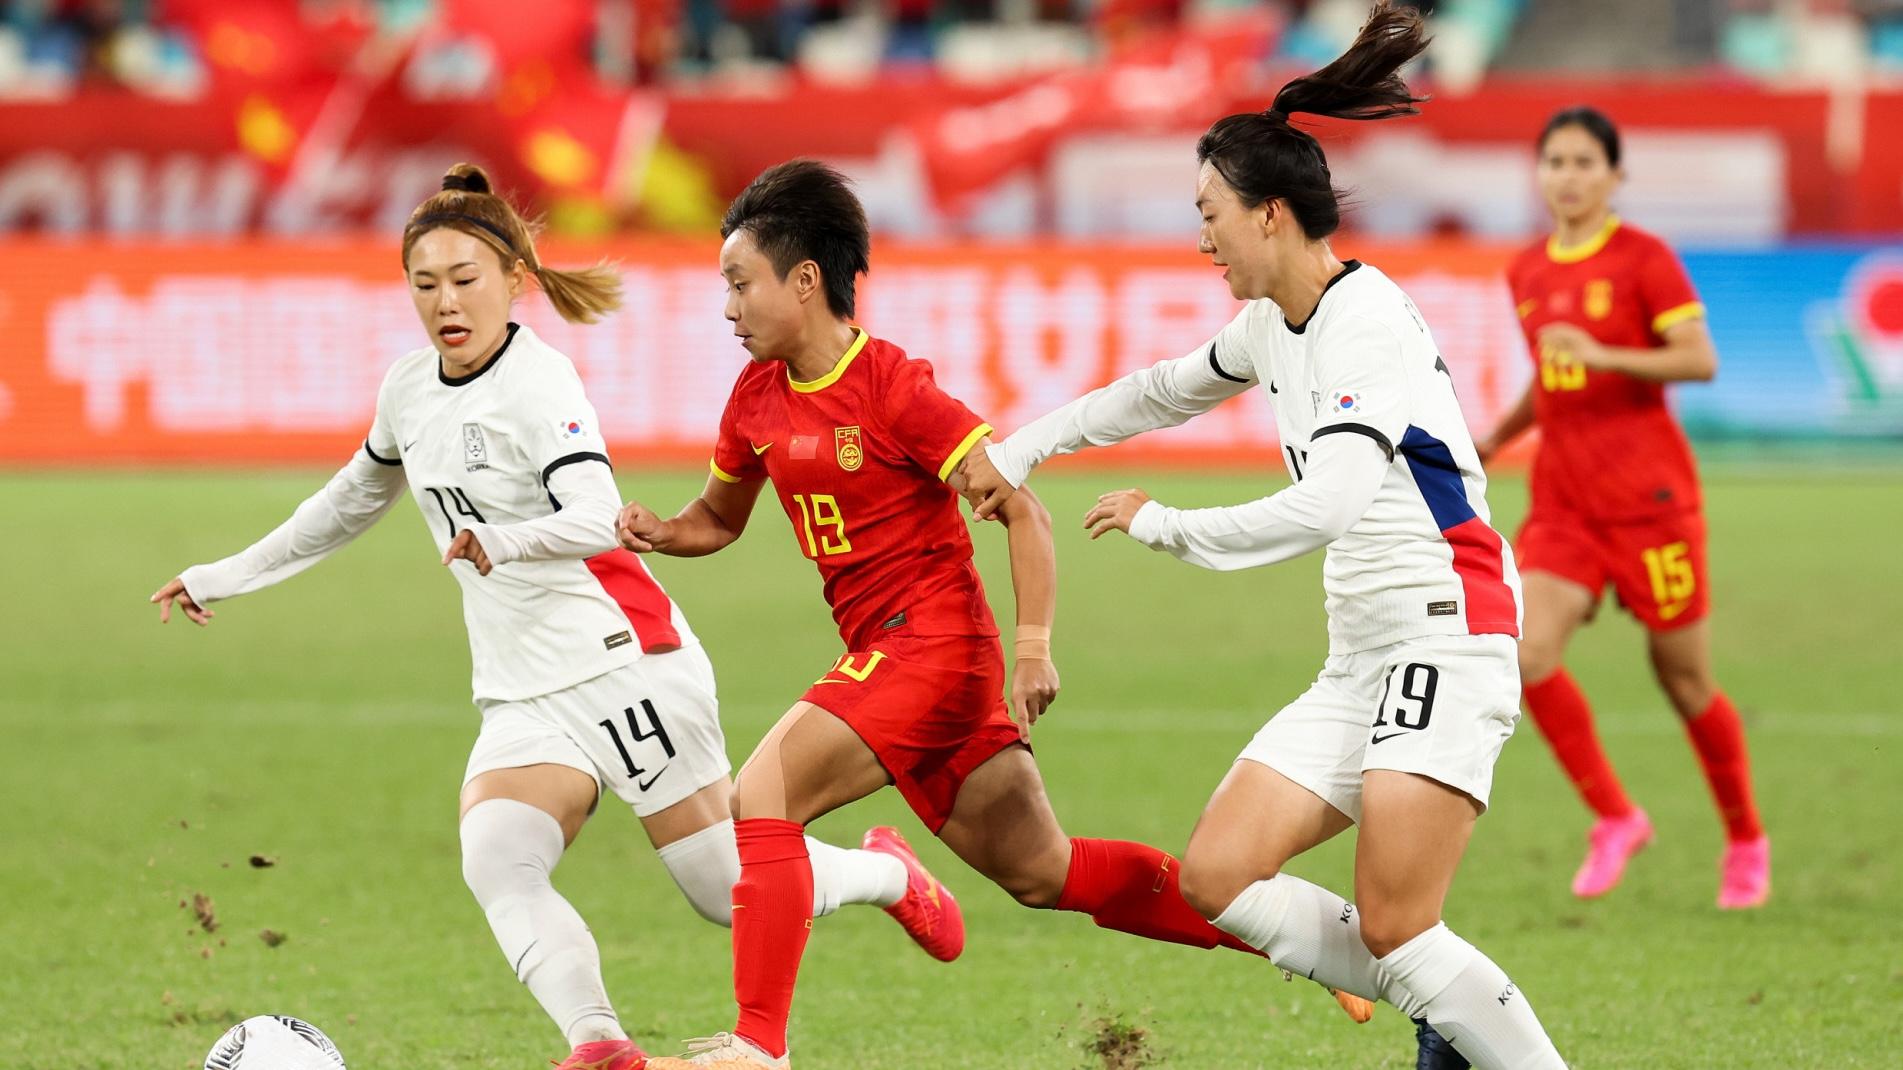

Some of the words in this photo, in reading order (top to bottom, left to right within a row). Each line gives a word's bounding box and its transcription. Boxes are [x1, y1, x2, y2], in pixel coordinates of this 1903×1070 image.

[793, 494, 852, 556] 19
[1643, 541, 1696, 605] 15
[1372, 662, 1439, 731] 19
[598, 699, 676, 779] 14
